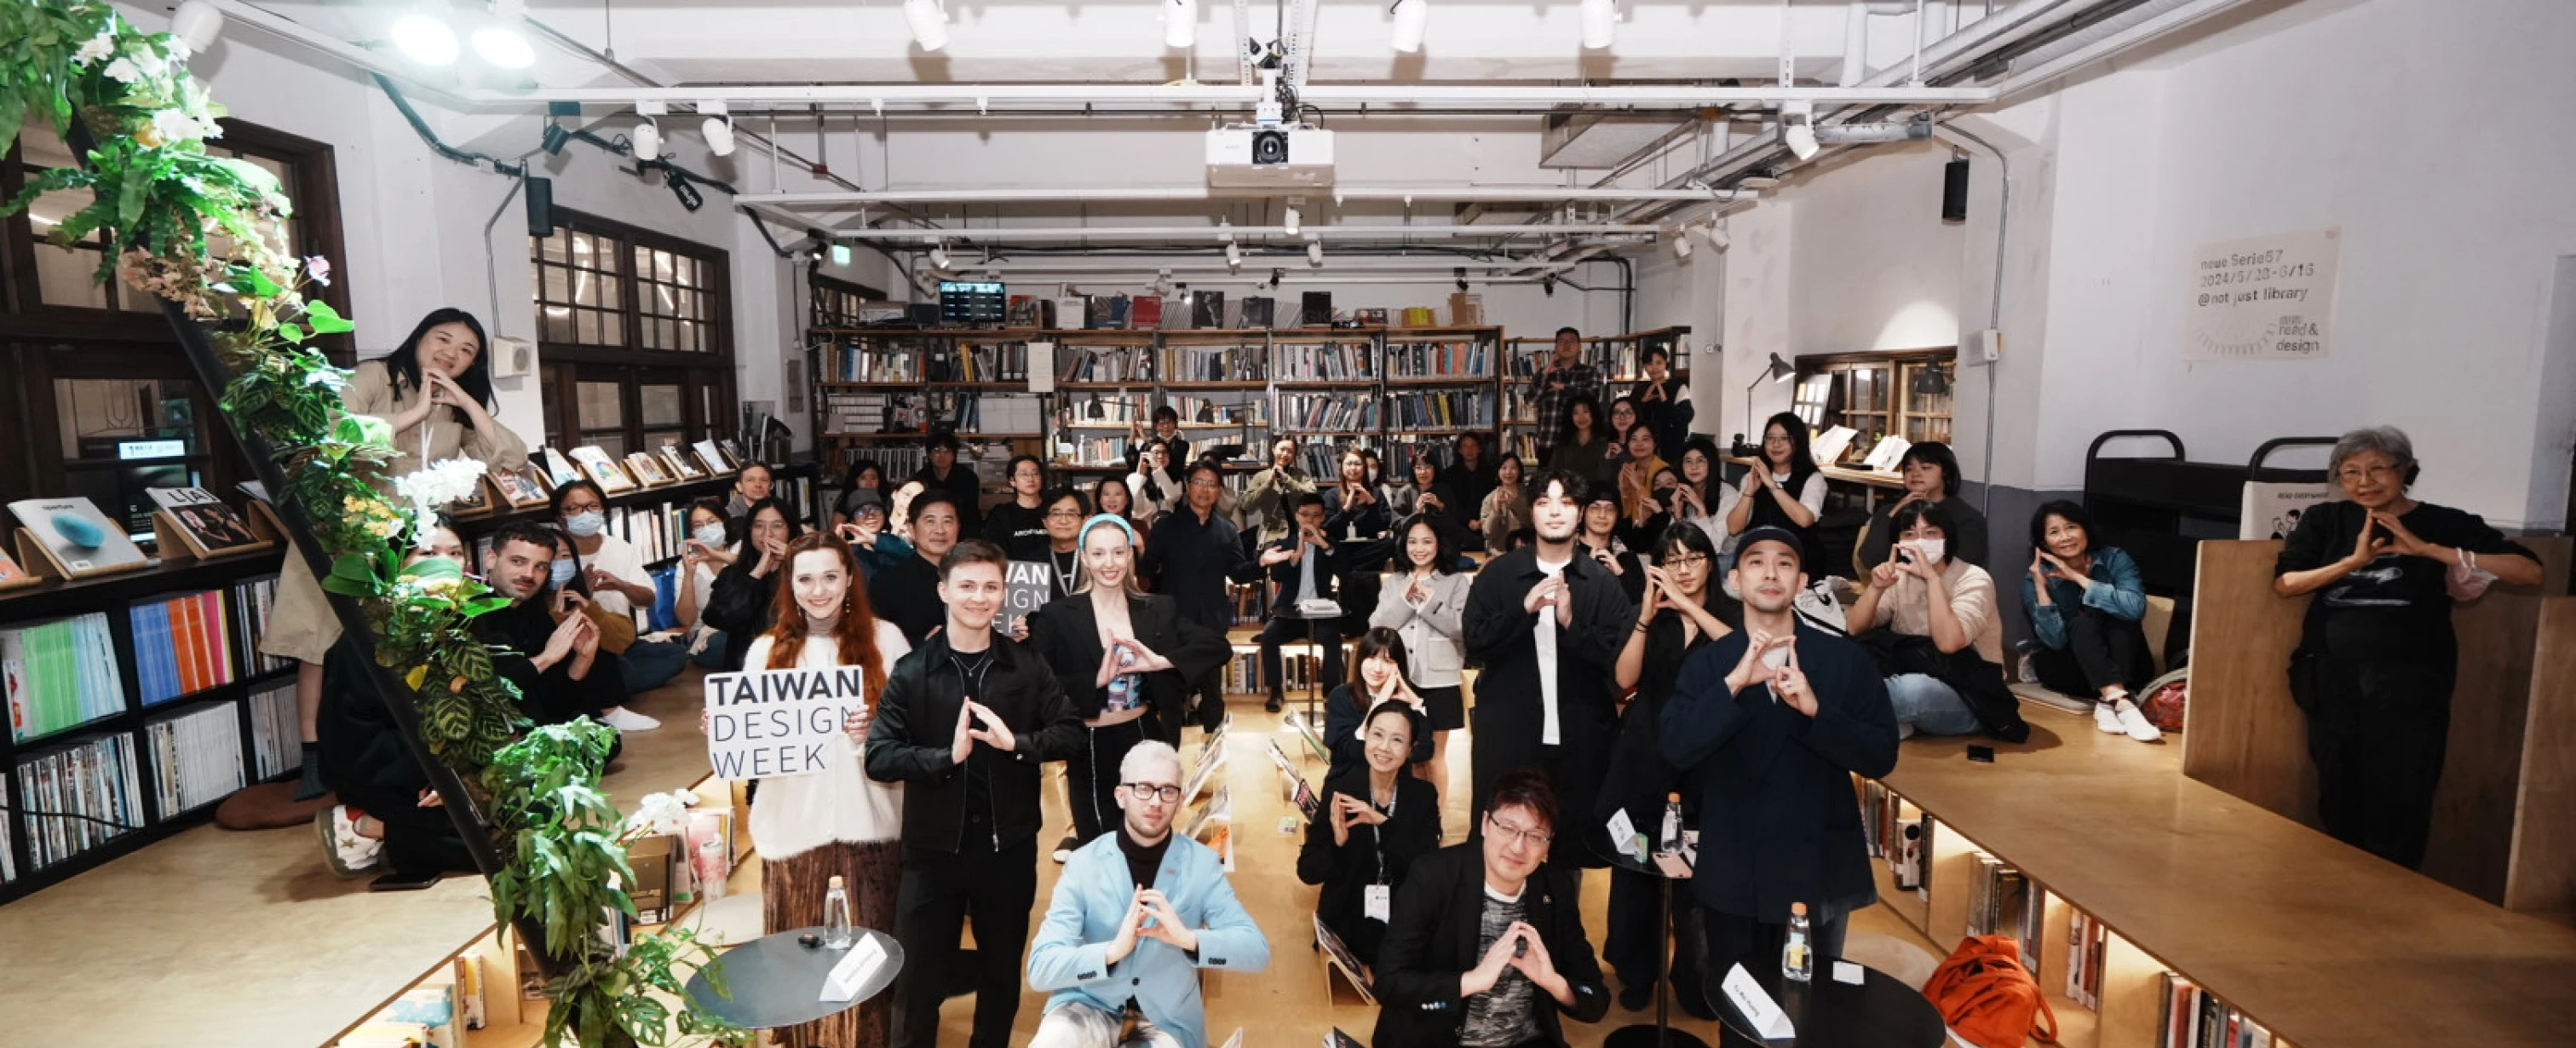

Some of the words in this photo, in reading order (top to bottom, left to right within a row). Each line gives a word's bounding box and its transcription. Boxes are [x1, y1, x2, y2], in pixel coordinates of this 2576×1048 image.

[2234, 290, 2258, 308] just
[2263, 286, 2309, 302] library
[2279, 323, 2307, 337] read
[2276, 340, 2320, 354] design
[1005, 587, 1049, 608] IGN
[709, 669, 860, 706] TAIWAN
[713, 743, 825, 779] WEEK
